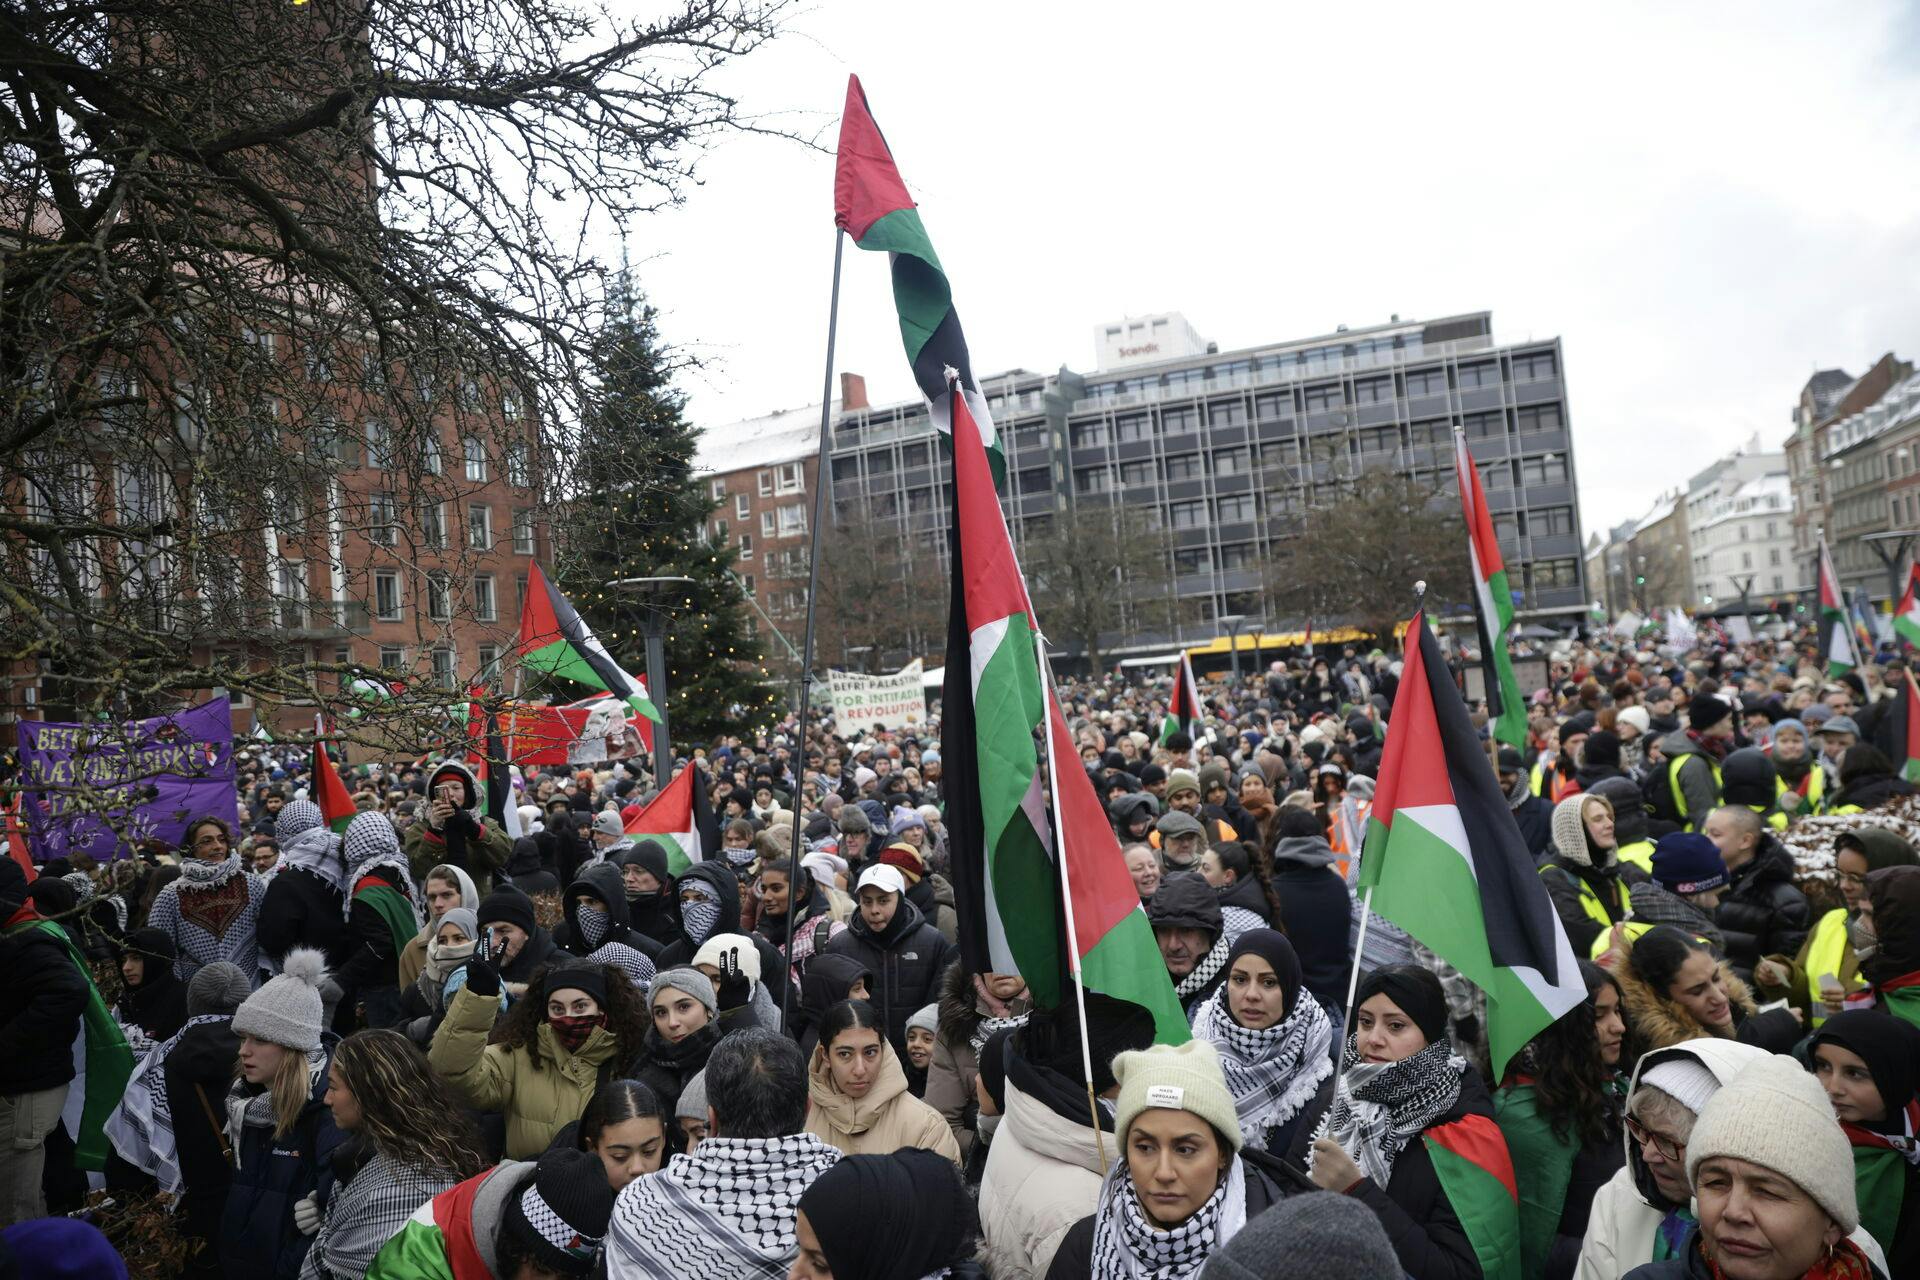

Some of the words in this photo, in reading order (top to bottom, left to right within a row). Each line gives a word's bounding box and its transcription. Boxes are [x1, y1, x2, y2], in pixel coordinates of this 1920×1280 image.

[1118, 343, 1160, 358] Scandic
[836, 695, 864, 706] FOR
[847, 701, 923, 718] REVOLUTION
